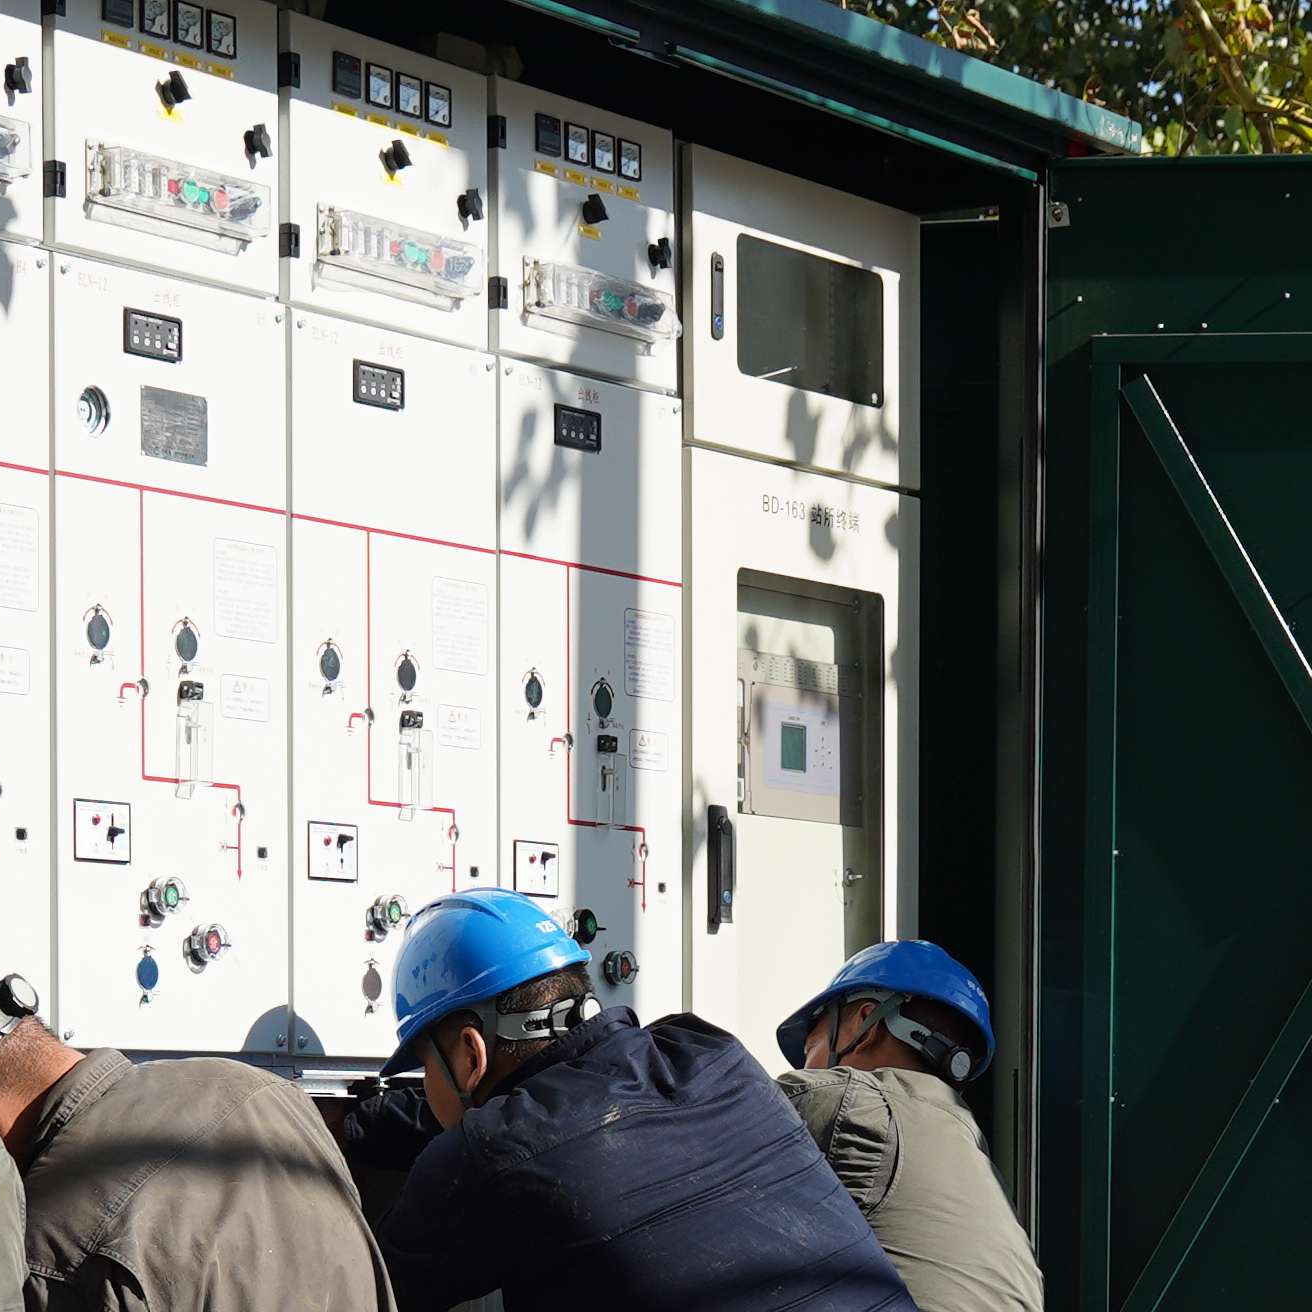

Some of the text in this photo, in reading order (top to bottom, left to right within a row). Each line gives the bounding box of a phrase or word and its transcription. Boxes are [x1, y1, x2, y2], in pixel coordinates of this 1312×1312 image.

[762, 494, 860, 534] BD-163 站所终端
